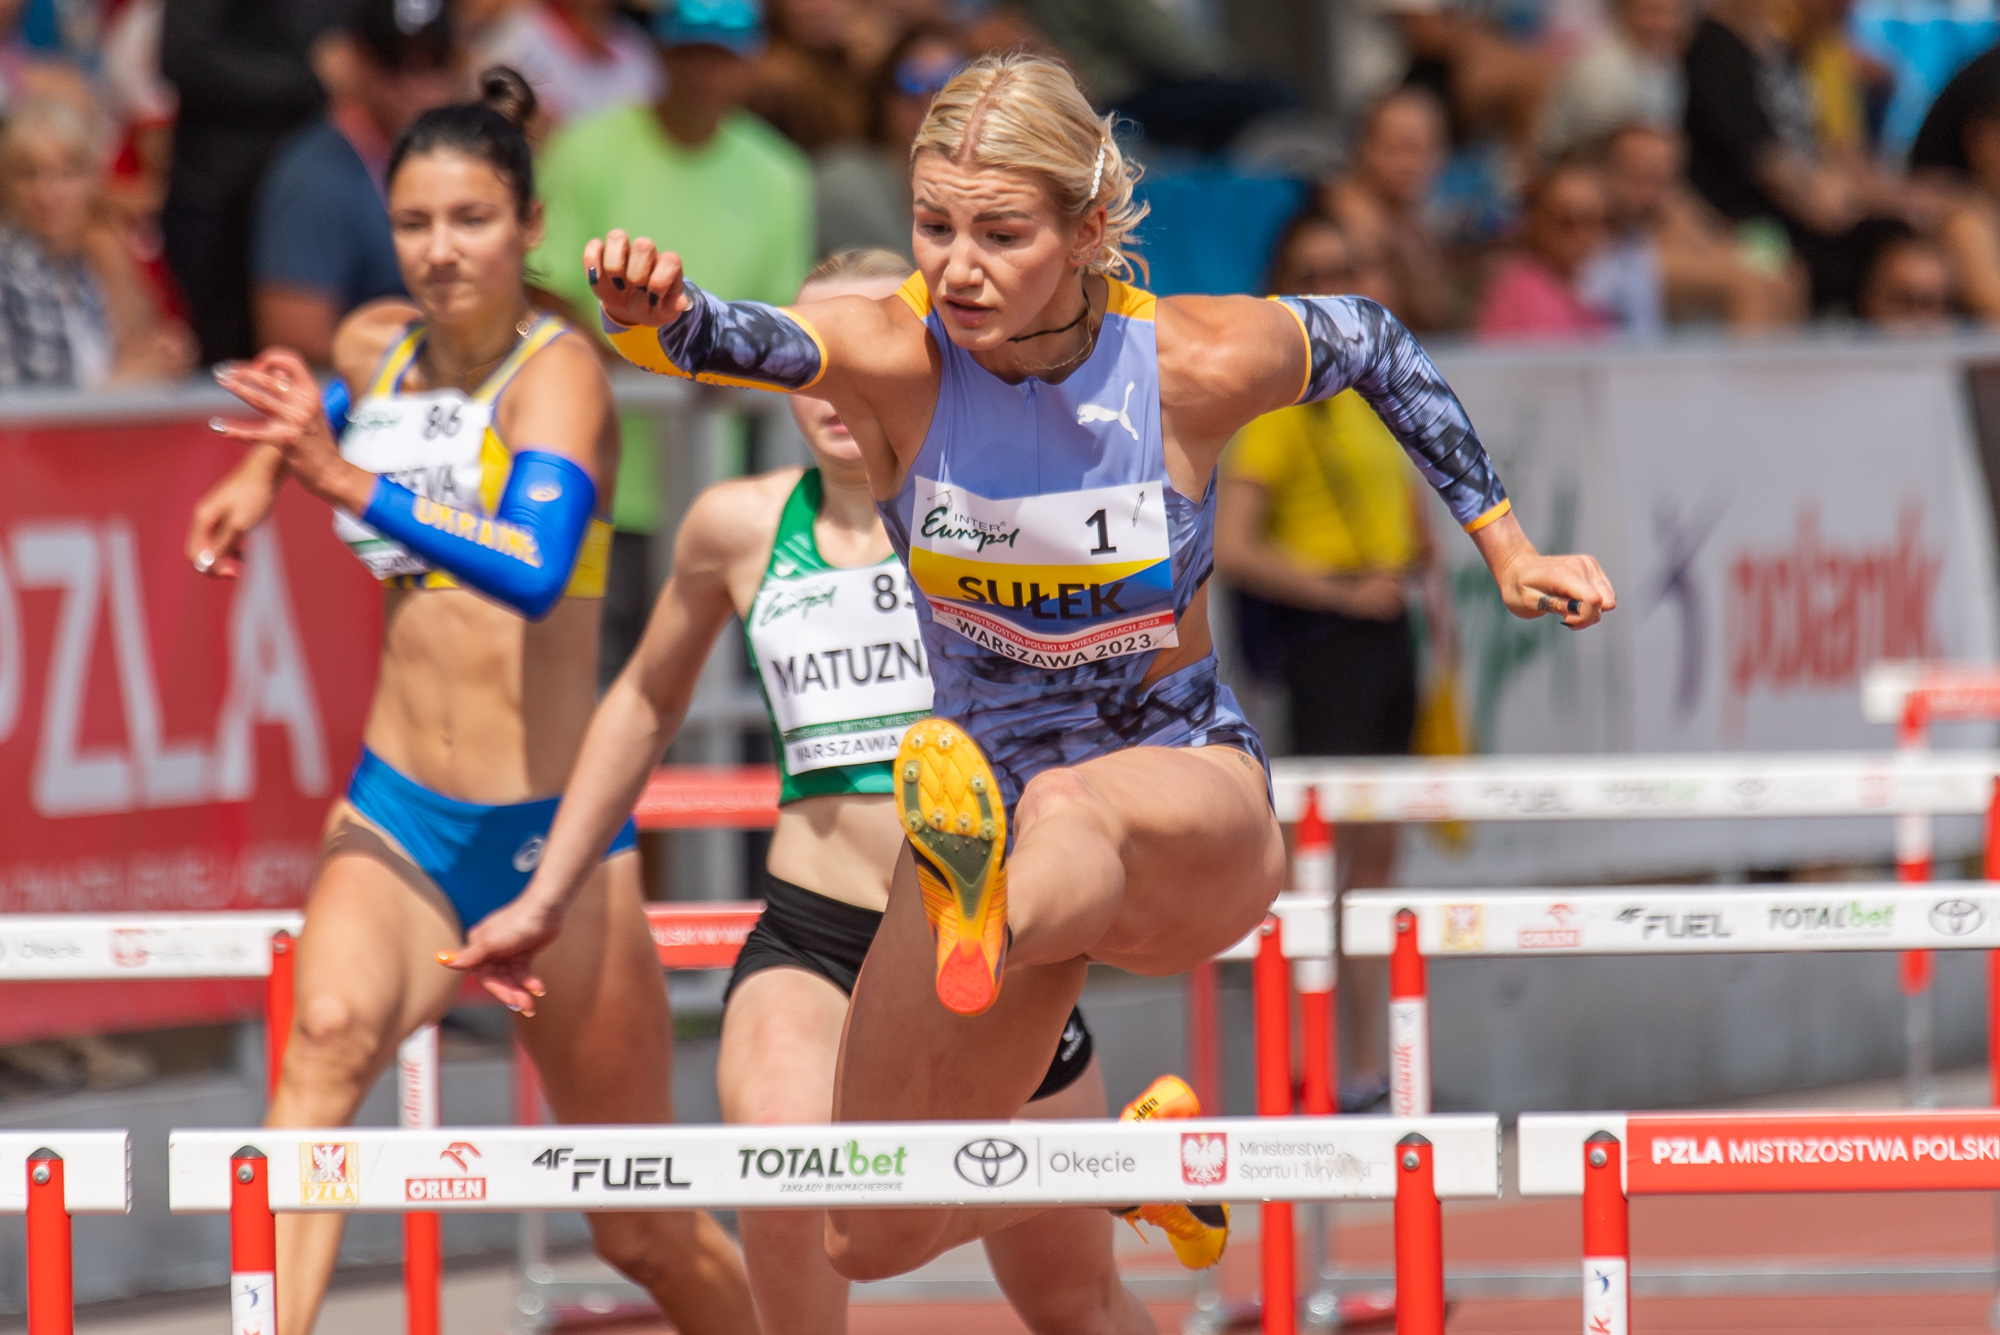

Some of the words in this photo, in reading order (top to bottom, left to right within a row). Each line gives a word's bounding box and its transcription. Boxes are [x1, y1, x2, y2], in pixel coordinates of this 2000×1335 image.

[424, 405, 462, 440] 86
[414, 498, 542, 569] UKRAINE
[920, 506, 1020, 553] Europol
[1085, 508, 1117, 556] 1
[957, 576, 1127, 621] SUŁEK
[942, 605, 967, 619] PZLA
[966, 613, 1024, 645] MISTRZOSTWA
[1024, 637, 1059, 653] POLSKI
[1058, 641, 1070, 652] W
[1070, 625, 1137, 649] WIELOBOJACH
[1138, 617, 1161, 630] 2023
[958, 620, 1088, 668] WARSZAWA
[1094, 633, 1153, 660] 2023
[0, 514, 331, 818] ZLA
[771, 639, 930, 695] MATUZN
[794, 733, 899, 764] WARSZAWA
[1642, 912, 1732, 941] FUEL
[1767, 899, 1895, 931] TOTALbet
[737, 1139, 909, 1180] TOTALbet
[1049, 1151, 1136, 1178] Okęcie
[1239, 1141, 1336, 1157] Ministerstwo
[1651, 1137, 1724, 1164] PZLA
[1727, 1136, 1909, 1164] MISTRZOSTWA
[1912, 1133, 2000, 1161] POLSKI
[408, 1179, 483, 1200] ORLEN
[572, 1156, 693, 1193] FUEL
[779, 1183, 823, 1193] ZAKŁADY
[825, 1182, 904, 1193] BUKMACHERSKIE
[1239, 1164, 1291, 1182] Sportu
[303, 1183, 355, 1203] PZLA
